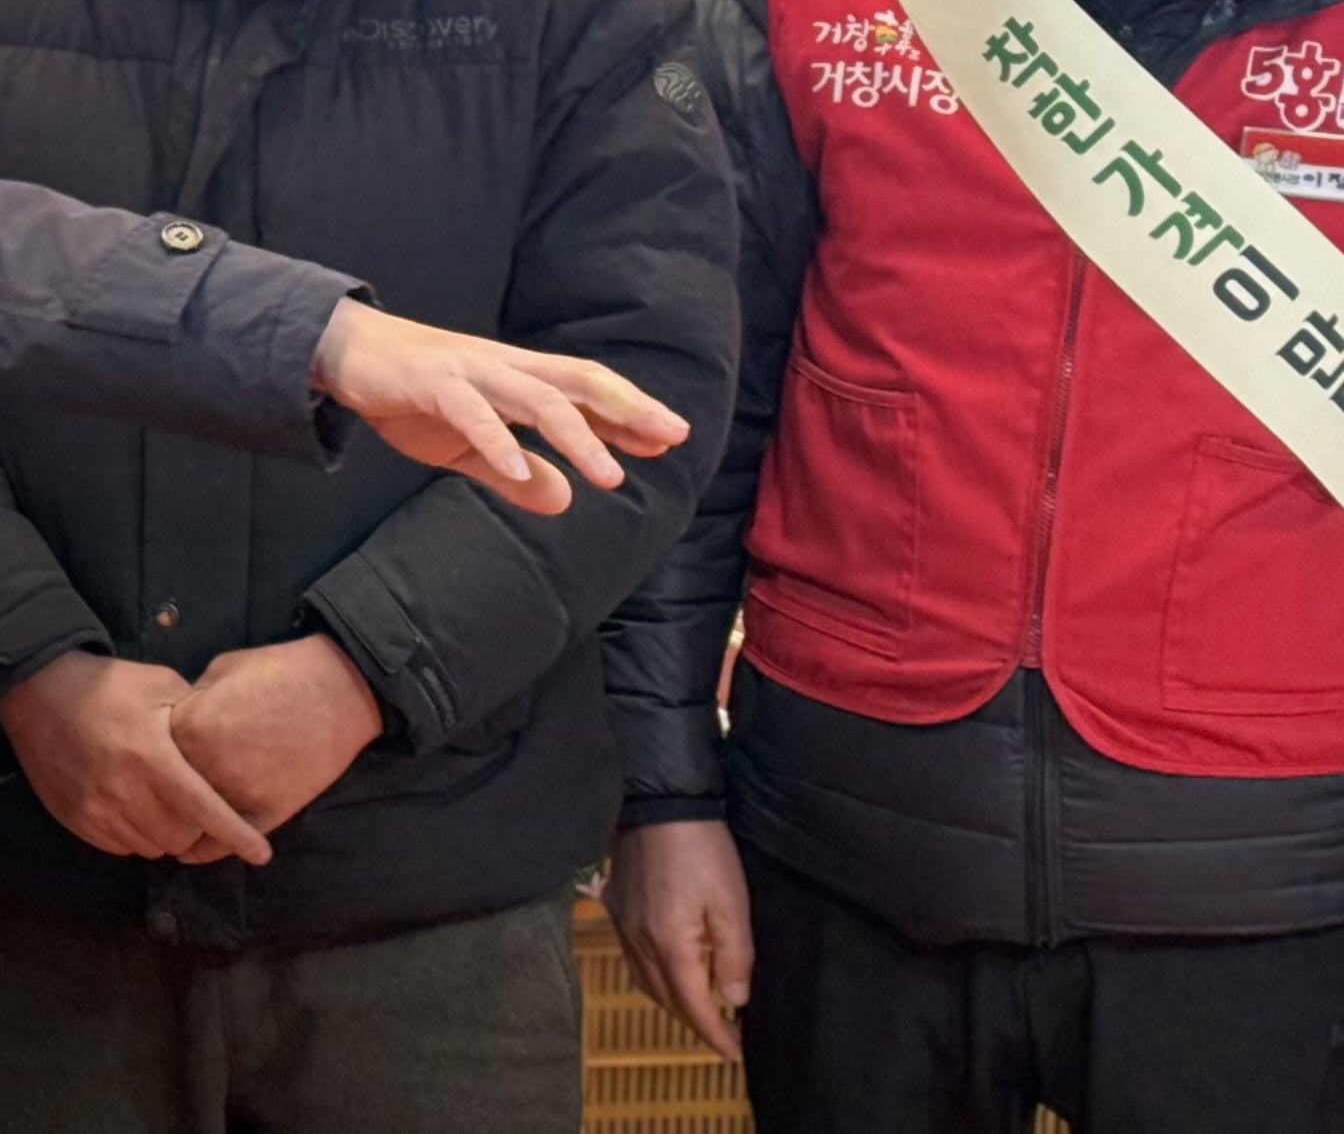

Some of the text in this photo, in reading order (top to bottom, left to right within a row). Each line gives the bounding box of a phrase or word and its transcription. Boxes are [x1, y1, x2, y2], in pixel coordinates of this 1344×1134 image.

[810, 61, 960, 115] 거창시장
[982, 17, 1115, 155] 착한
[1092, 140, 1300, 322] 가격이
